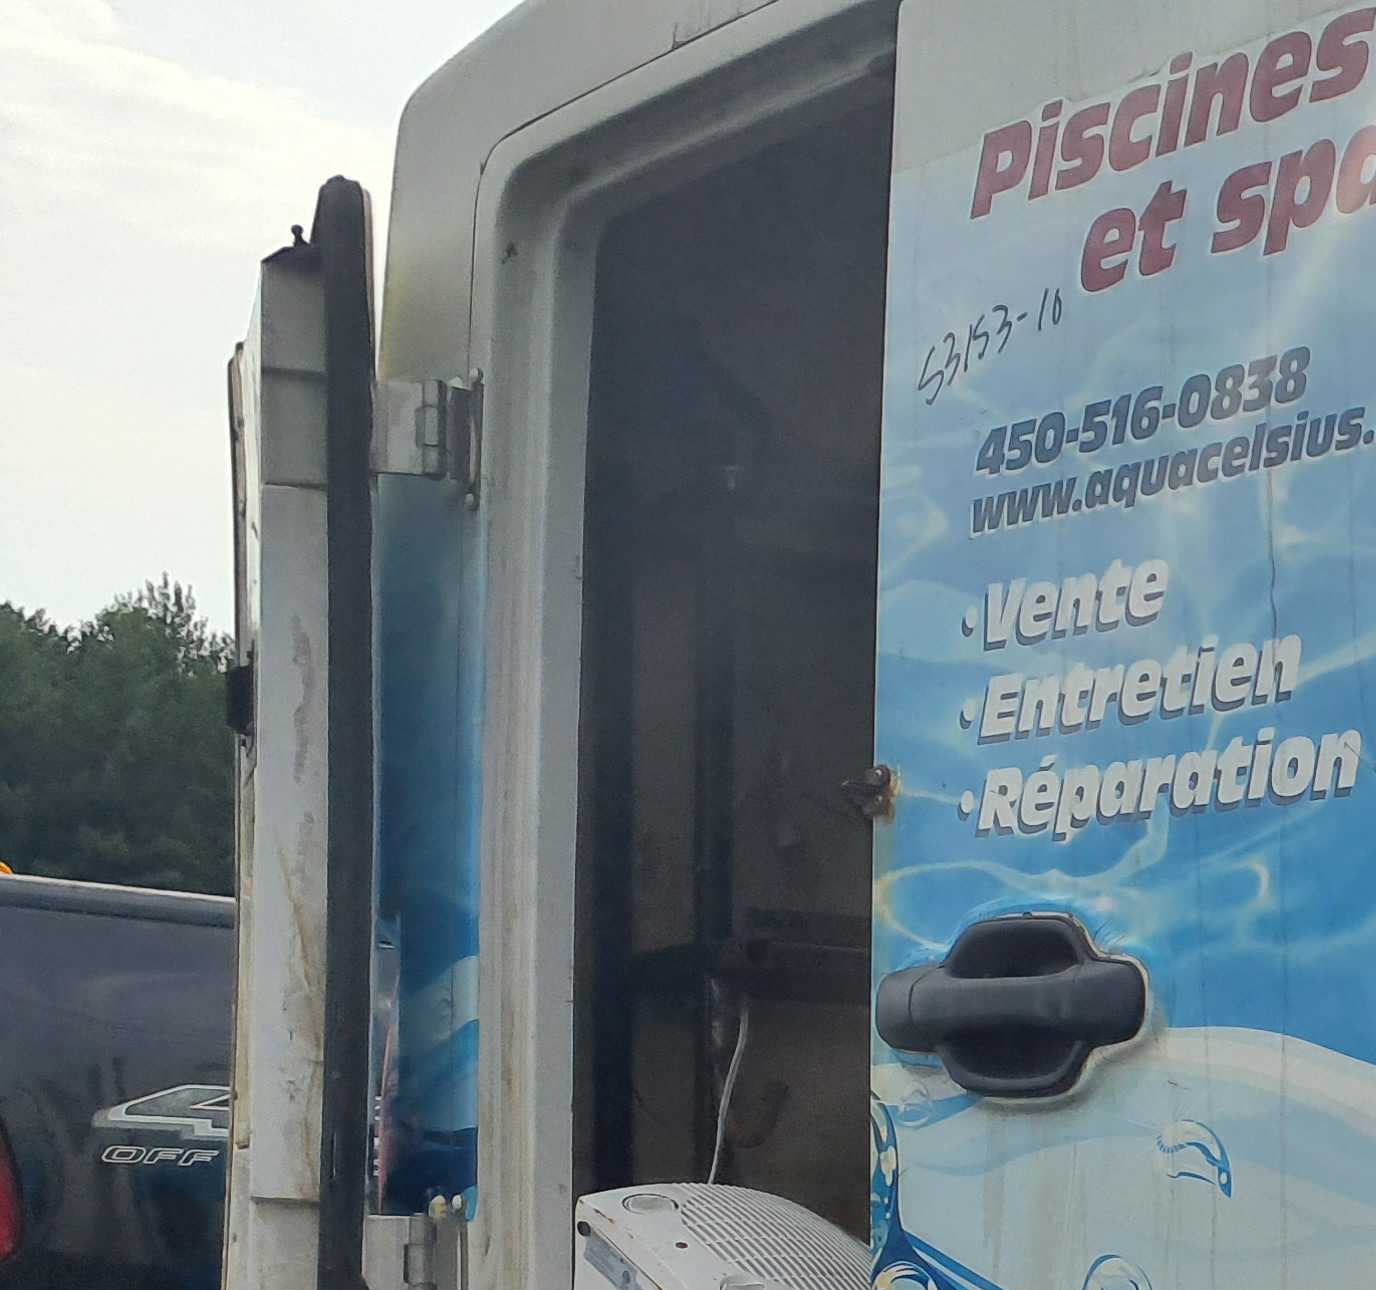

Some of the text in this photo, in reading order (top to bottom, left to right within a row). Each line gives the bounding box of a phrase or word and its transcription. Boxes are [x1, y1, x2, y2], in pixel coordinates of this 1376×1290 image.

[969, 7, 1376, 220] Piscines
[1080, 180, 1187, 292] et
[974, 346, 1311, 475] 450-516-0838
[101, 1145, 220, 1167] OFF
